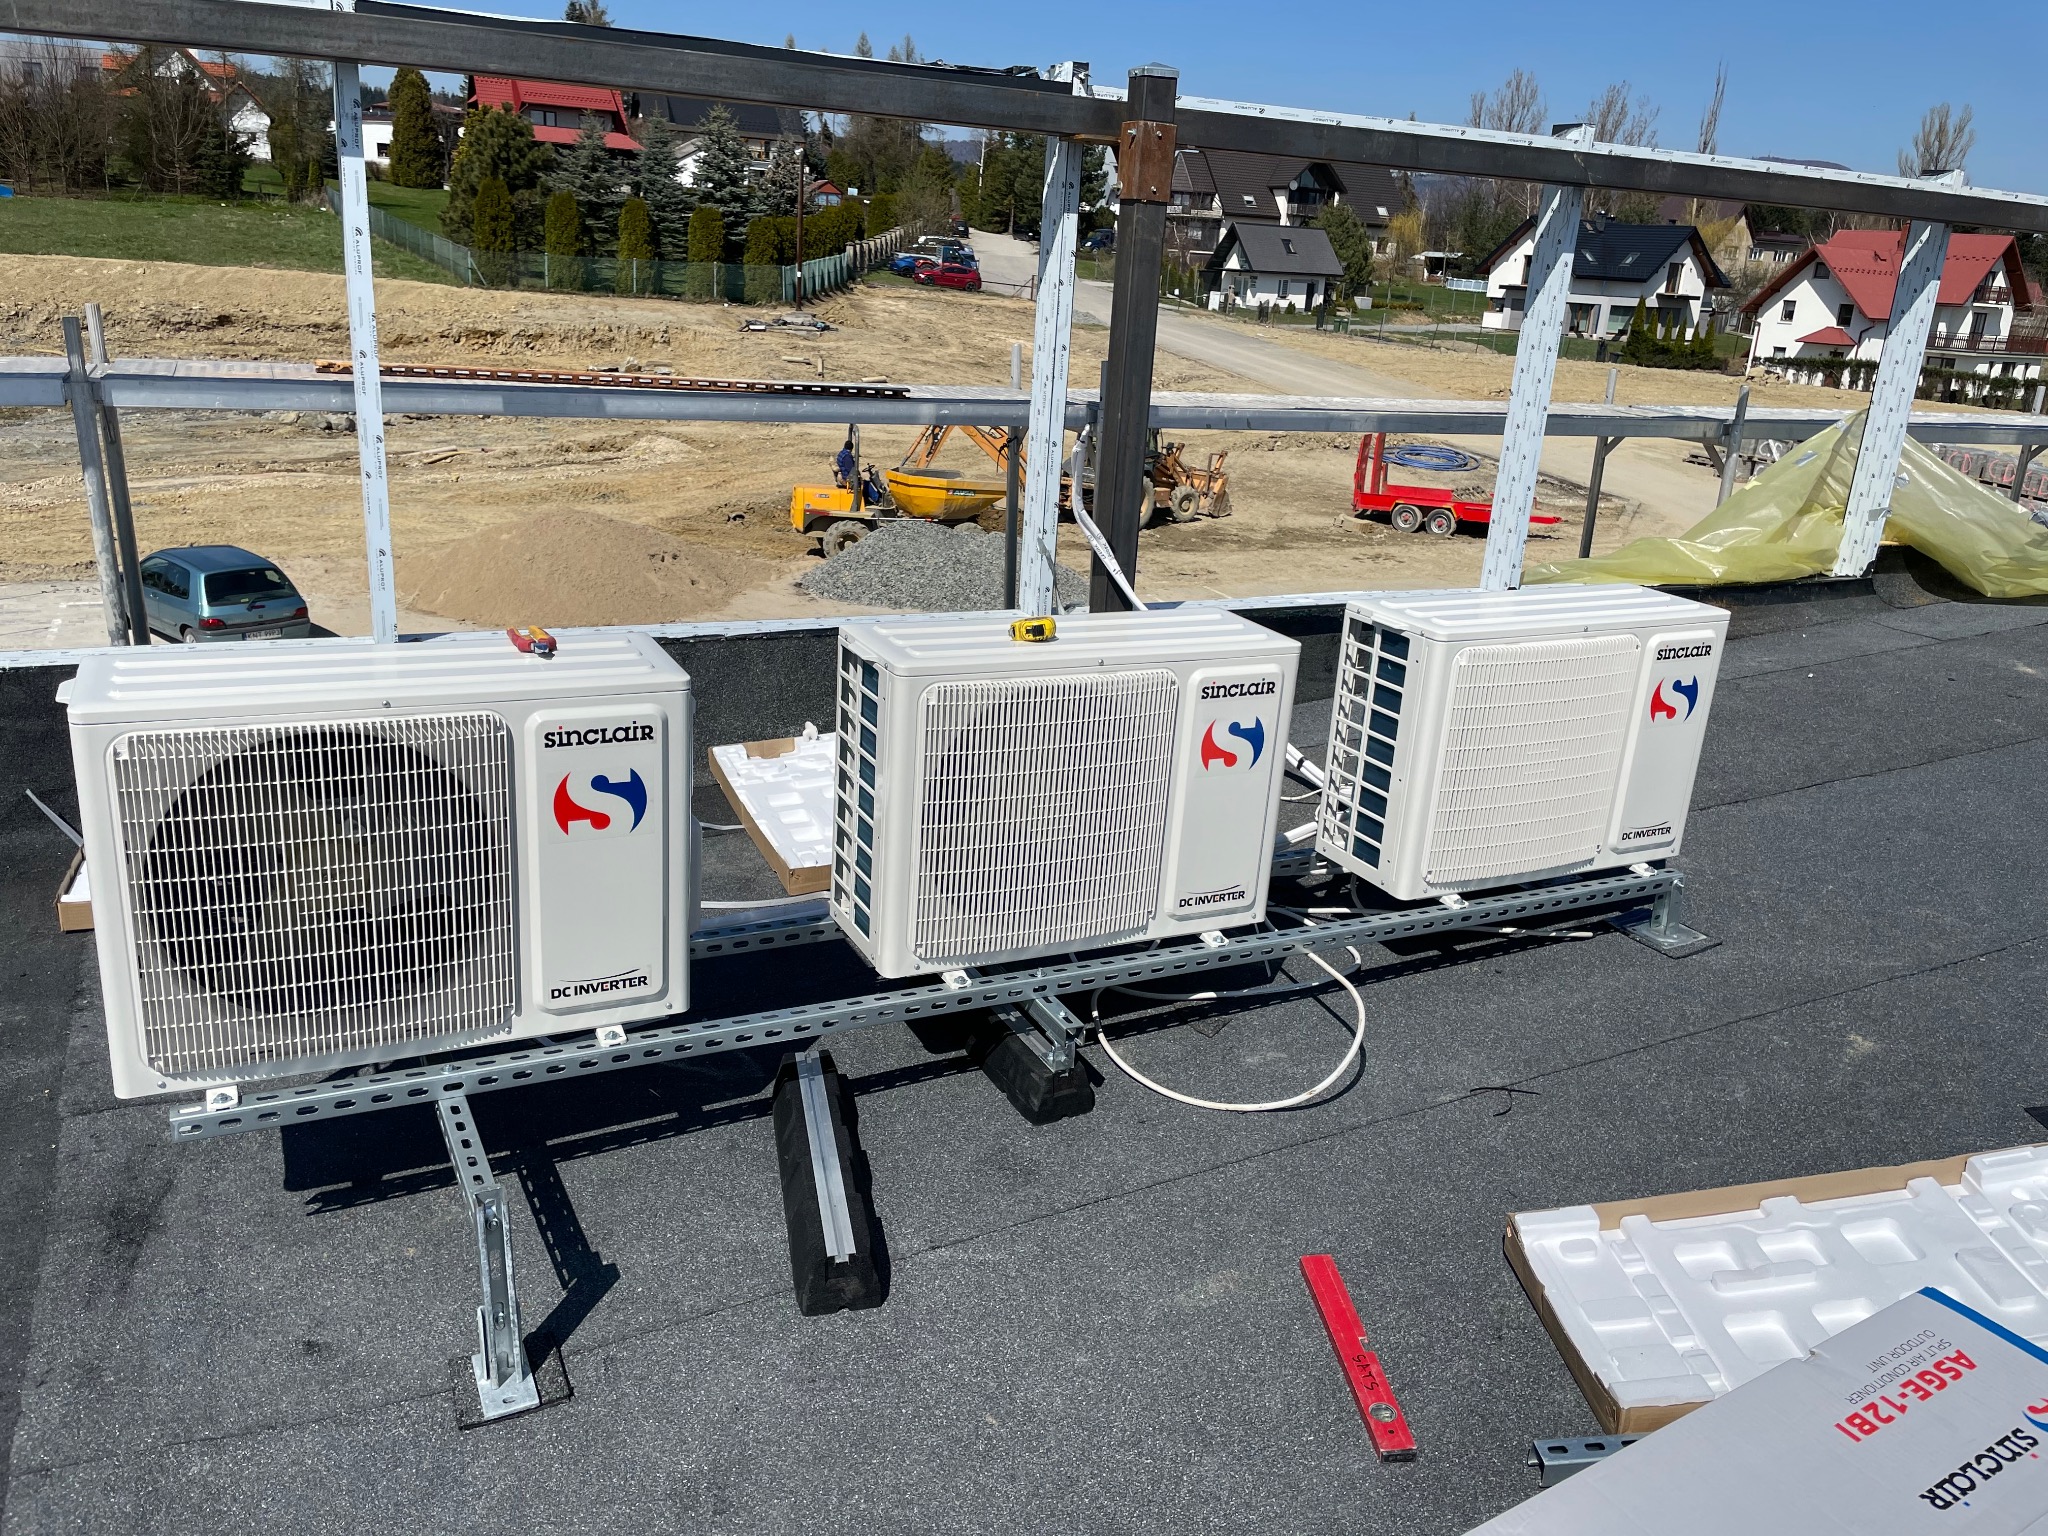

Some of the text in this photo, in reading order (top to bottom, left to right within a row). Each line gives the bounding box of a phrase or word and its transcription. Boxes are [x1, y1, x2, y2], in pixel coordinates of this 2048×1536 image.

[355, 240, 363, 276] ALUPROF
[1622, 826, 1672, 841] DC INVERTER
[1179, 891, 1246, 908] DC INVERTER
[551, 975, 648, 999] DC INVERTER
[1865, 1329, 1936, 1373] OUTDOOR UNIT
[1844, 1338, 1952, 1405] SPLIT AIR CONDITIONER
[1834, 1349, 1978, 1443] ASGE-12BI
